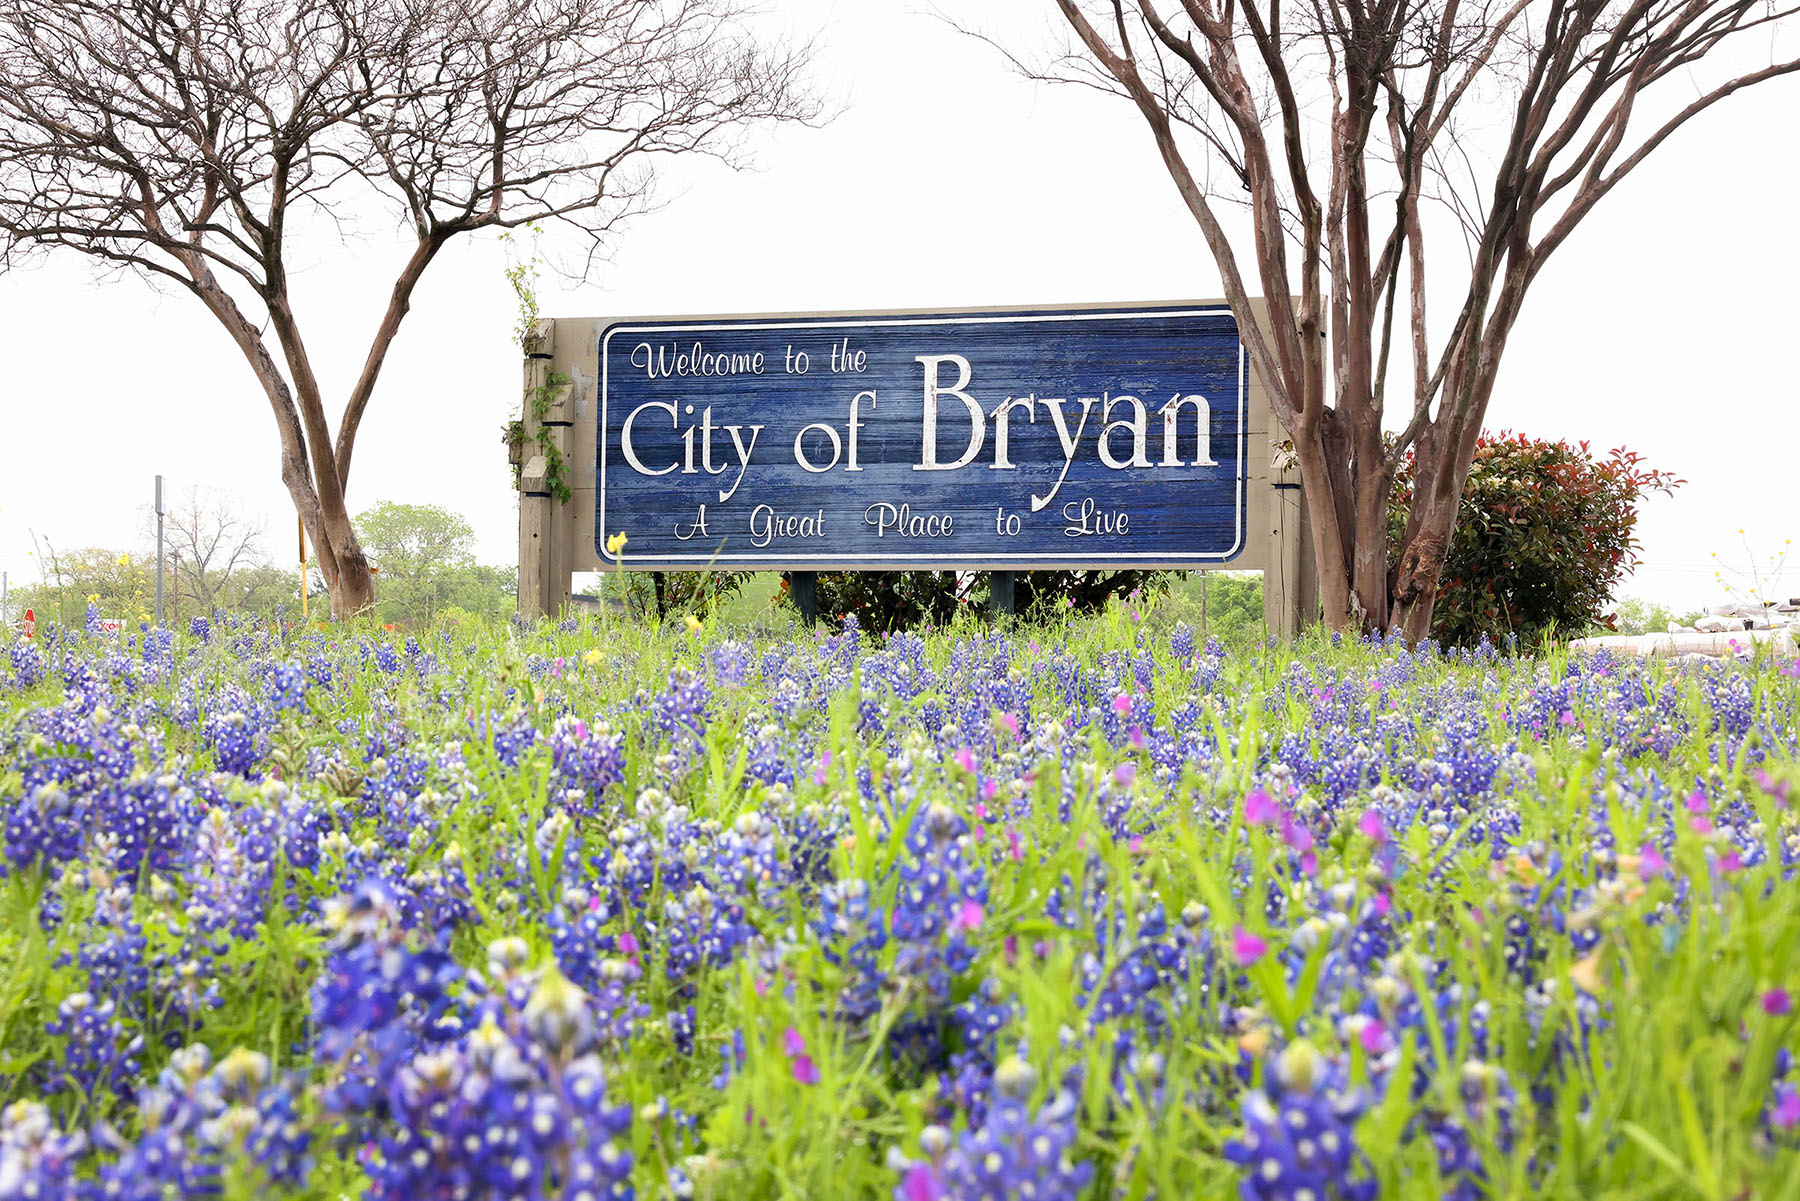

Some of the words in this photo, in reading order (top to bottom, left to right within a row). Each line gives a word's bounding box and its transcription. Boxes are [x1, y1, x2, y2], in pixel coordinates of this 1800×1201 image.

[630, 341, 765, 379] Welcome
[784, 344, 810, 374] to
[830, 337, 867, 373] the
[621, 399, 765, 503] City
[793, 389, 877, 473] of
[912, 353, 1219, 512] Bryan
[674, 503, 710, 540] A
[749, 503, 826, 548] Great
[864, 502, 953, 538] Place
[996, 507, 1021, 537] to
[1063, 497, 1129, 537] Live
